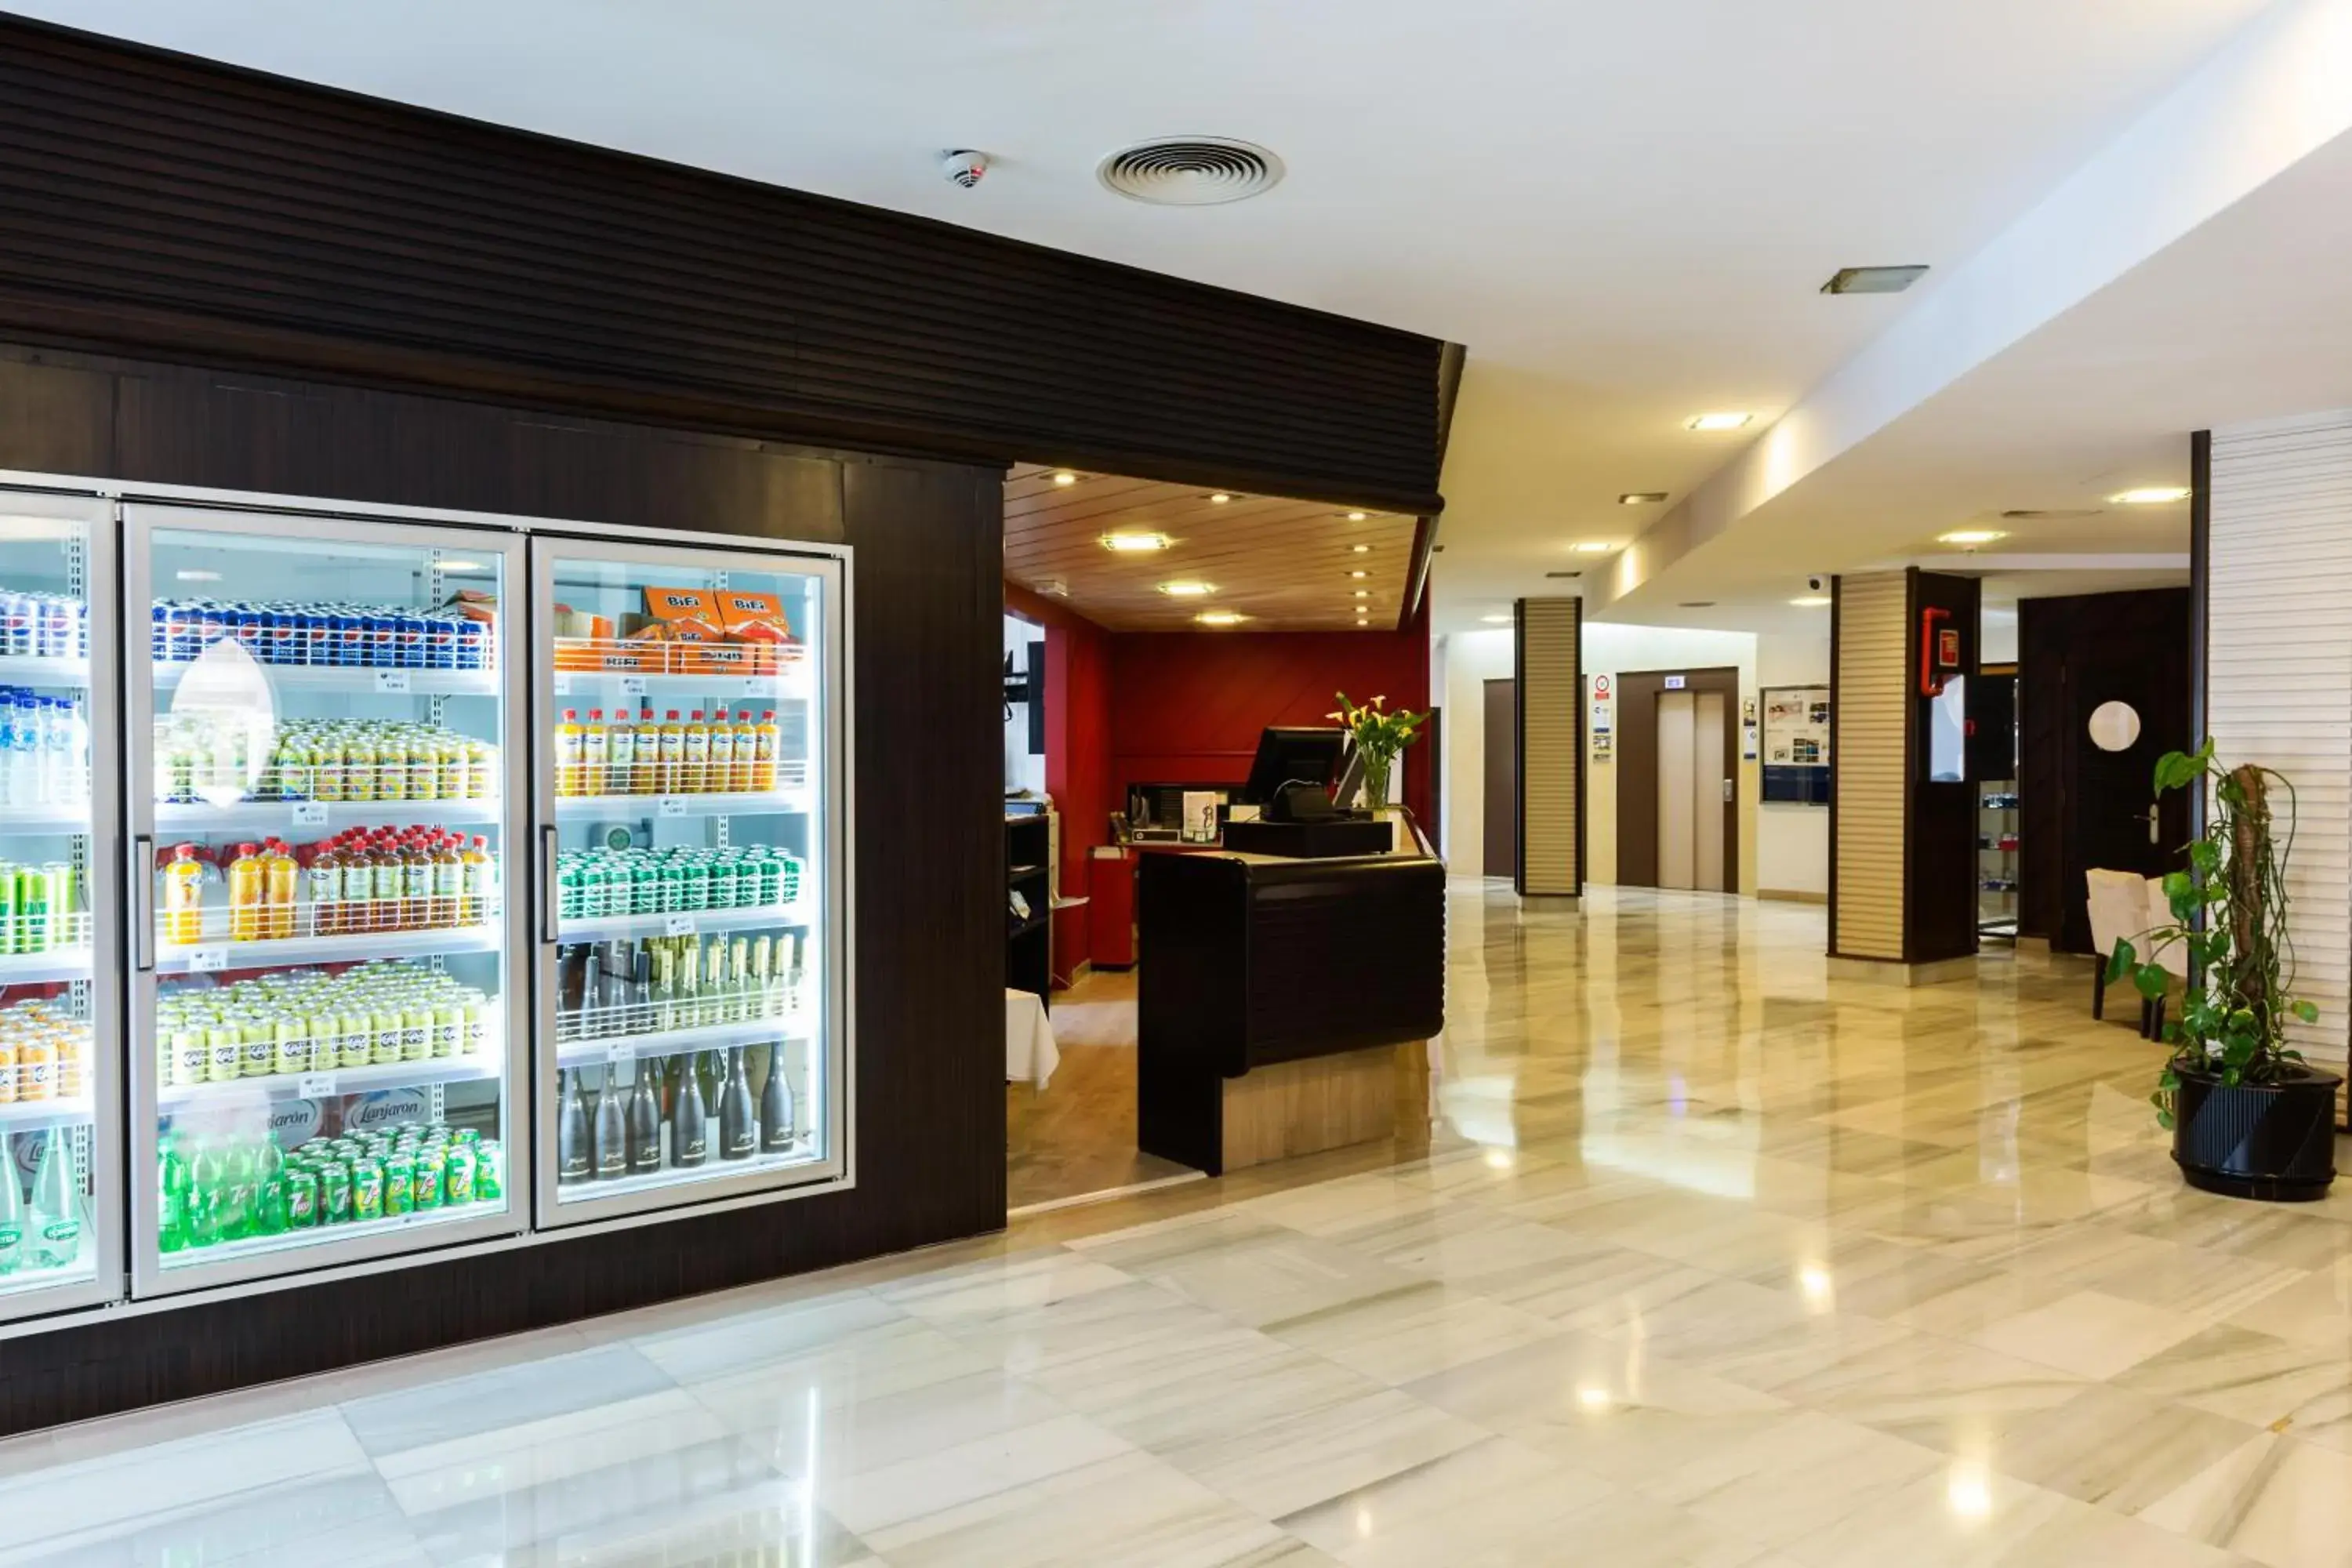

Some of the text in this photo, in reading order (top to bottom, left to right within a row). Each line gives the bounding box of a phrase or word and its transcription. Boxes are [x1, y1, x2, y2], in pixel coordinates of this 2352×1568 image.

[667, 597, 699, 607] BiFi
[734, 599, 766, 610] BiFi
[269, 1110, 308, 1129] jarón
[360, 1102, 417, 1123] Lanjarón
